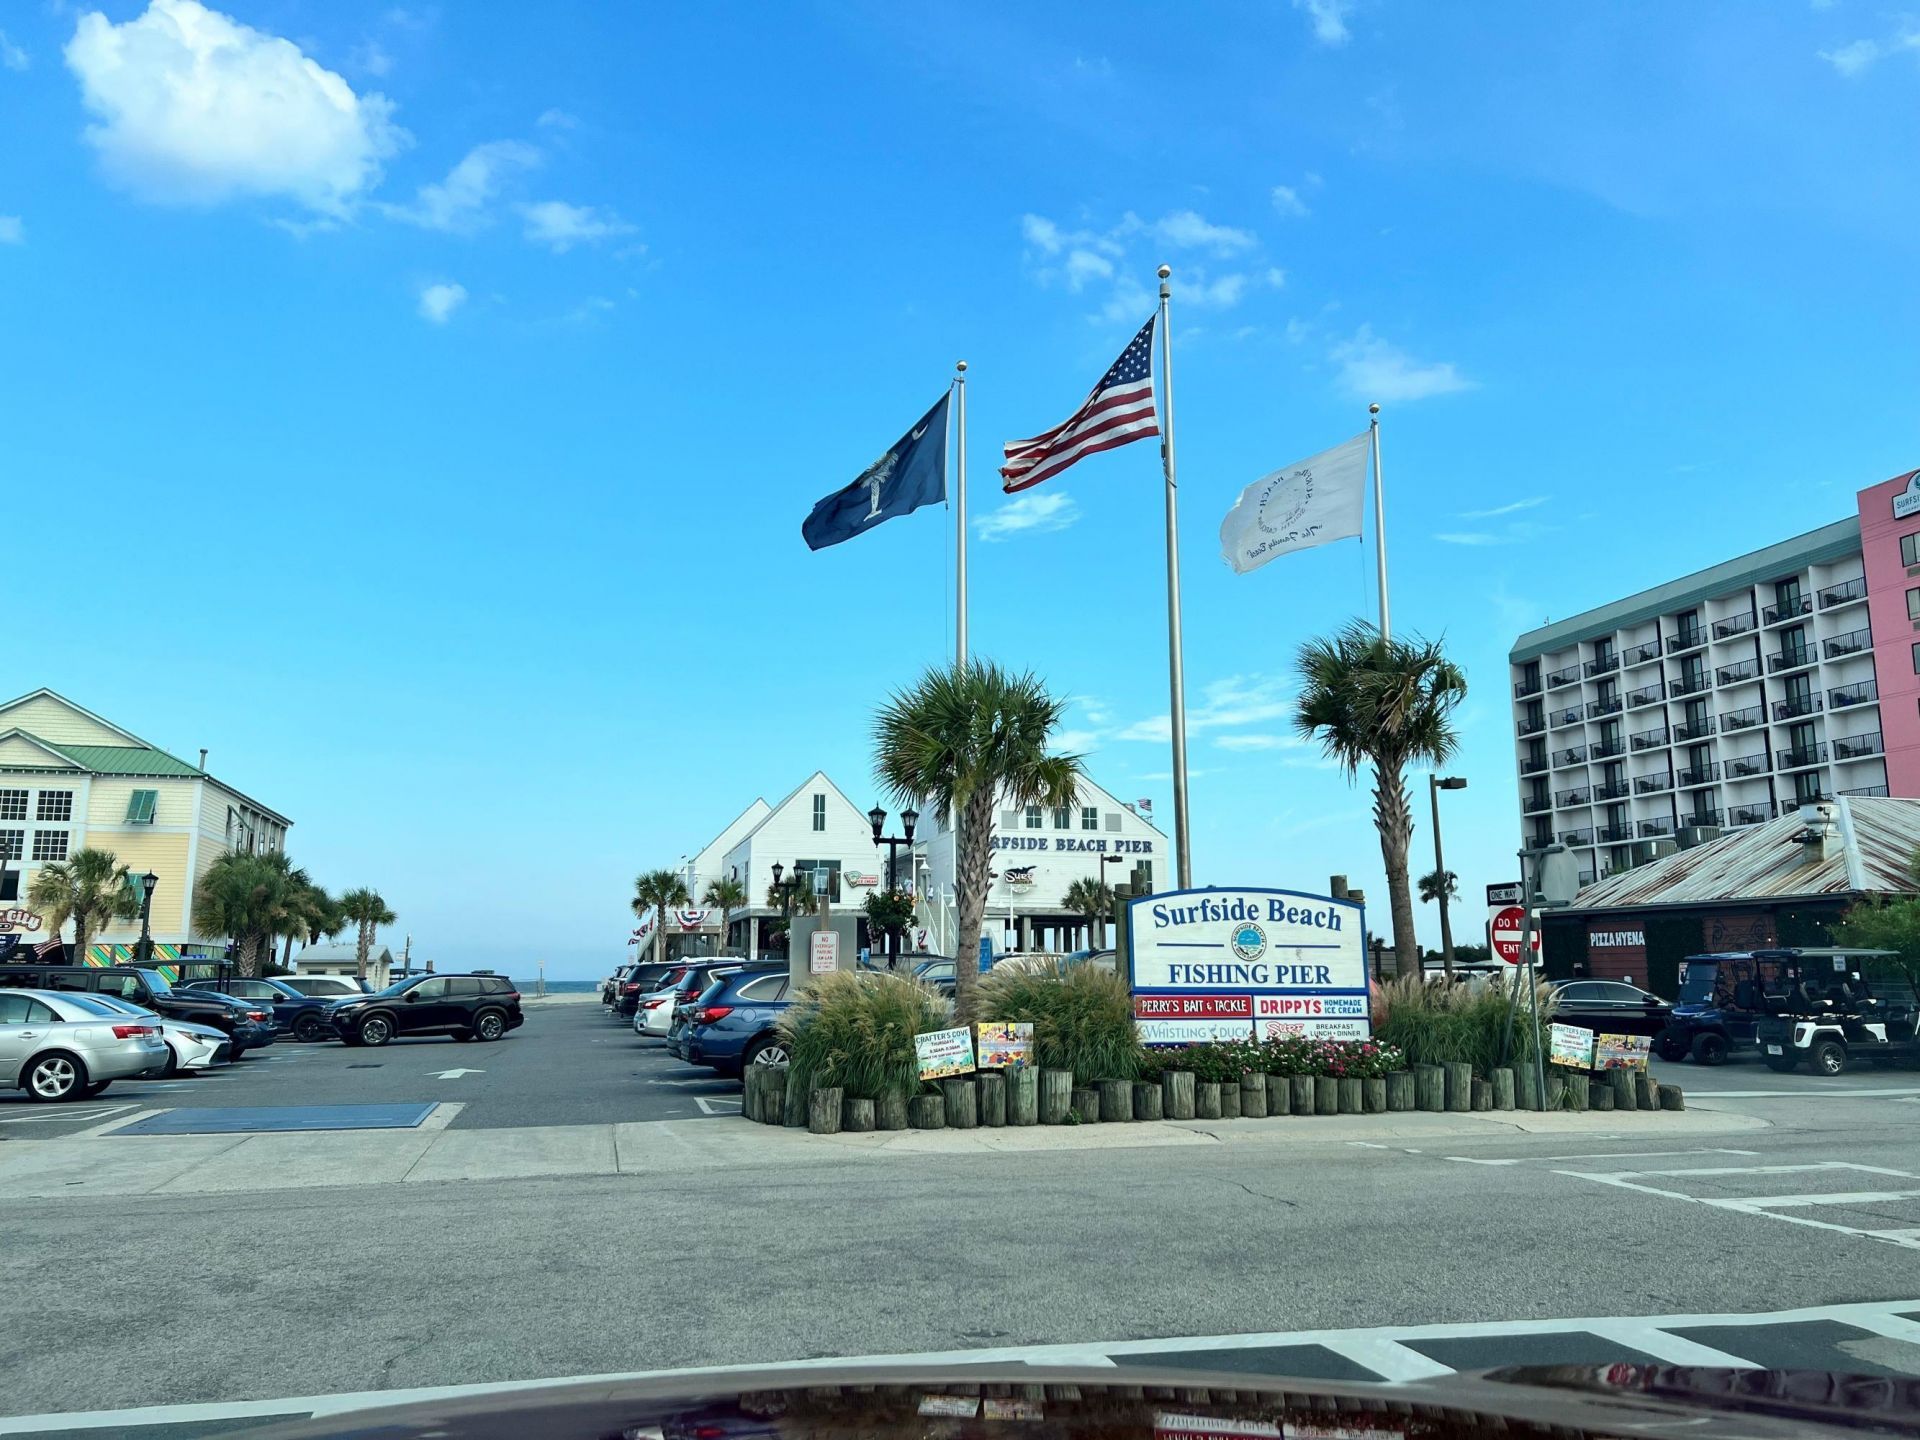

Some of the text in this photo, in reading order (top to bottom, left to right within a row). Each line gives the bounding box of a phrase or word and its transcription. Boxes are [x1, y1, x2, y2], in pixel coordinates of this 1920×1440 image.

[1896, 495, 1920, 509] SURFSI
[990, 836, 1153, 853] RFSIDE BEACH PIER
[1490, 890, 1516, 900] ONE WAY
[1152, 898, 1341, 931] Surfside Beach
[1498, 918, 1510, 927] DO
[1503, 944, 1521, 954] ENT
[1168, 964, 1332, 984] FISHING PIER
[1142, 1000, 1247, 1012] PERRY'S BAIT & TACKLE
[1260, 999, 1322, 1014] DRIPPY'S
[952, 1030, 969, 1038] COVE
[1220, 1027, 1248, 1038] DUCK
